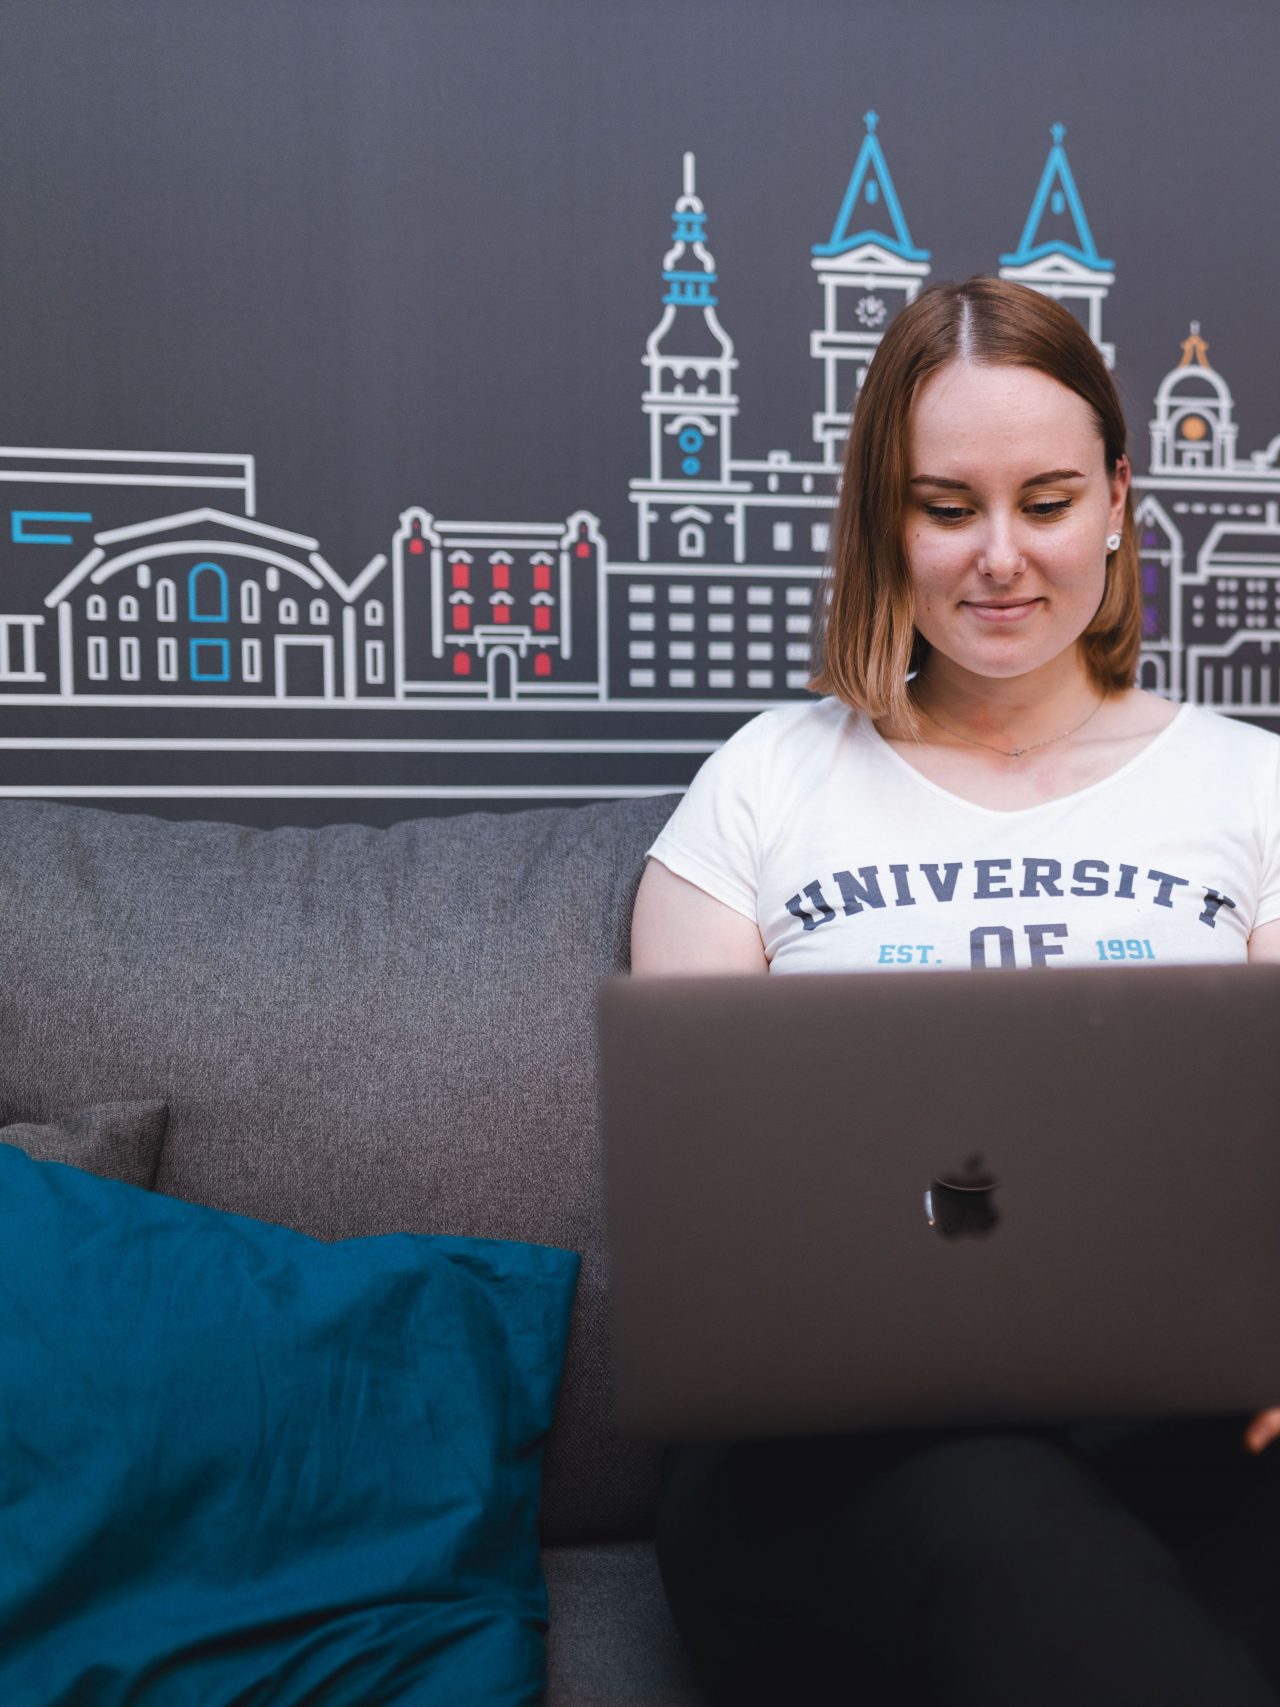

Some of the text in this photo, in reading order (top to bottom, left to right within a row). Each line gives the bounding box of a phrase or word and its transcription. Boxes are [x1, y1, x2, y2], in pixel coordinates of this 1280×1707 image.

[785, 858, 1236, 931] UNIVERSITY
[878, 923, 1155, 969] EST. OF 1991
